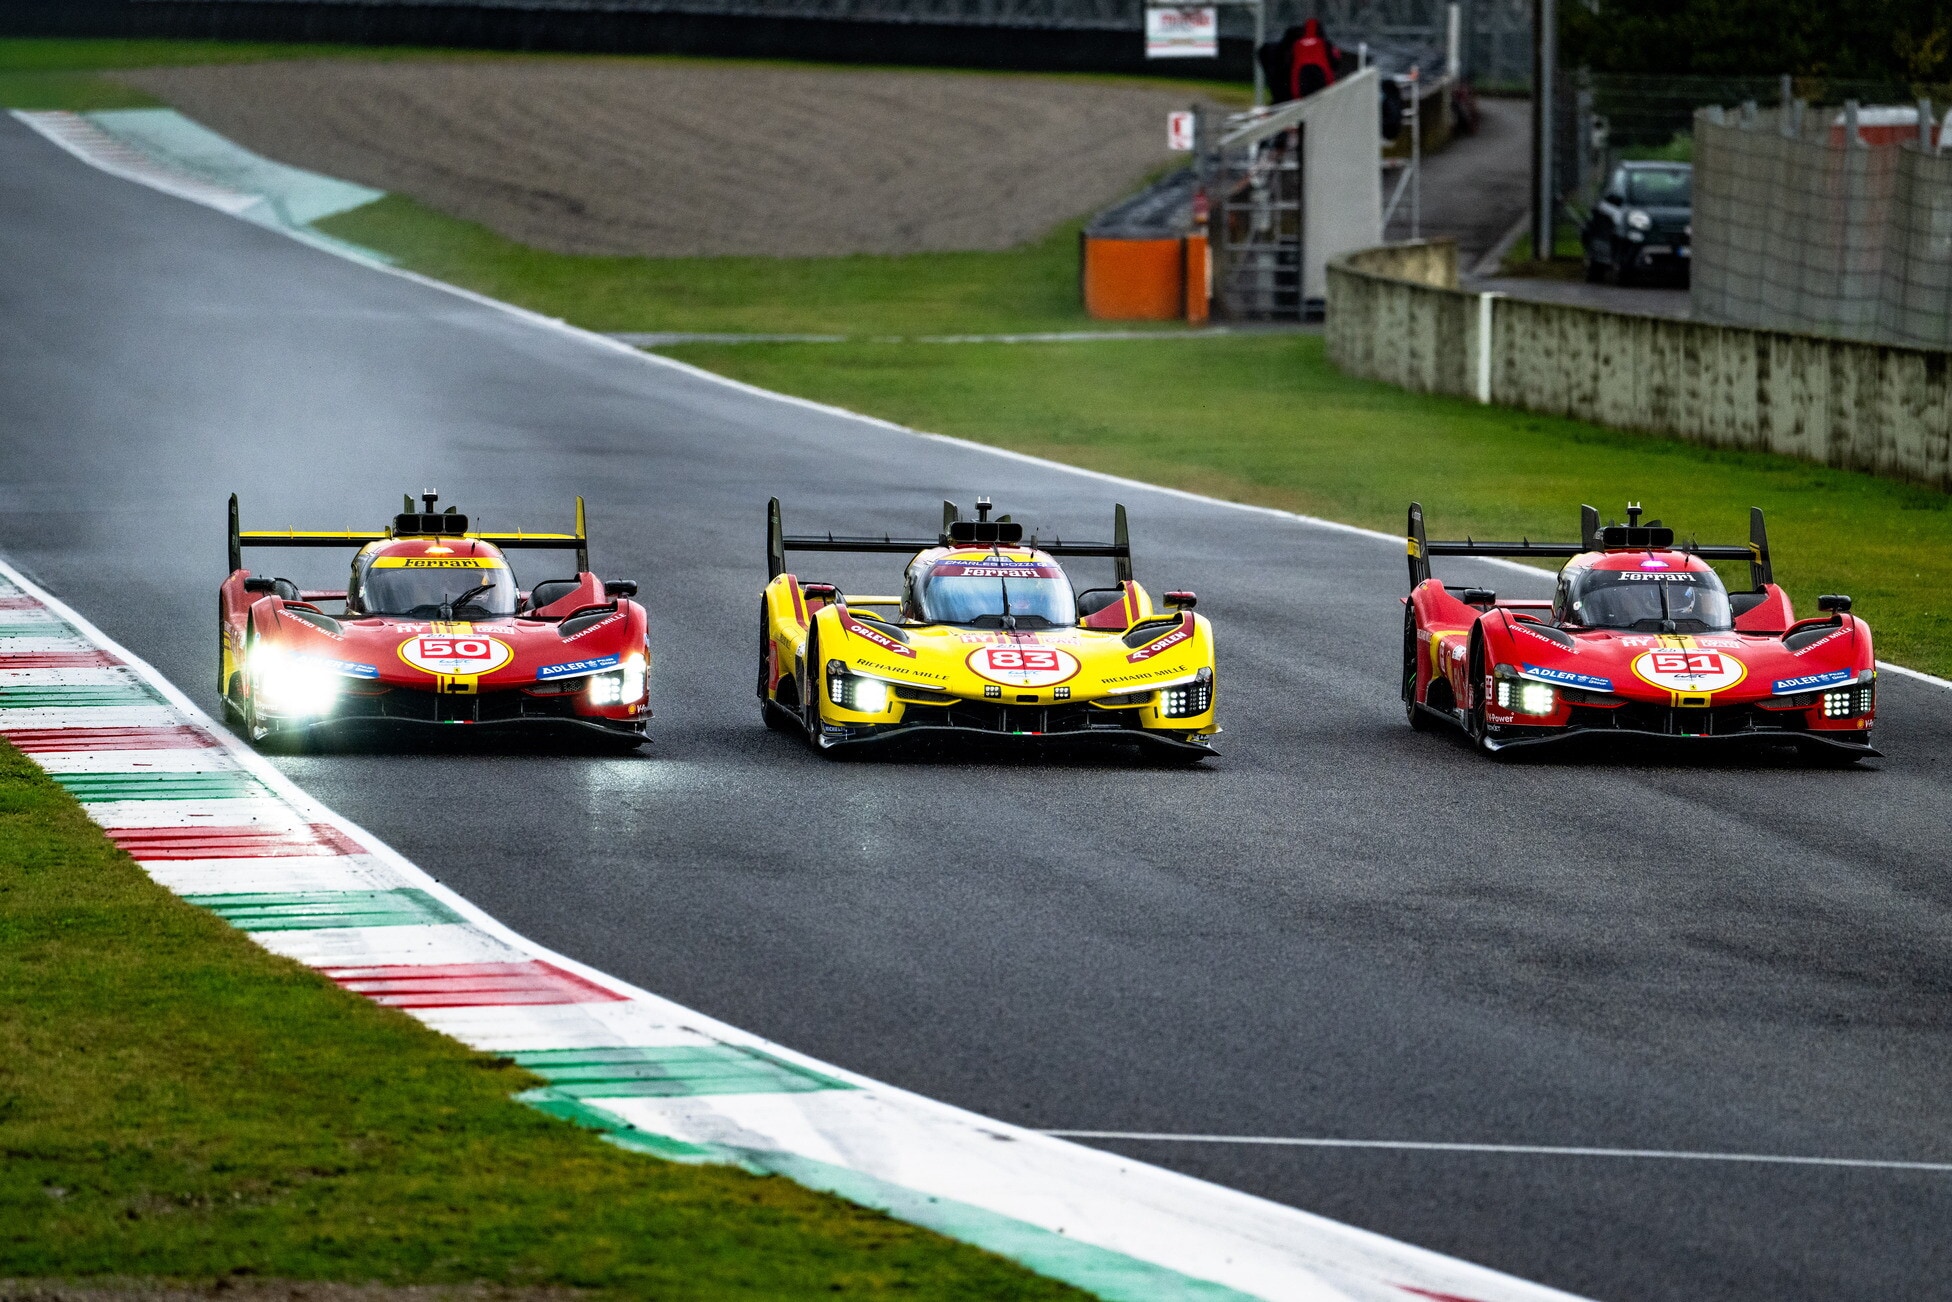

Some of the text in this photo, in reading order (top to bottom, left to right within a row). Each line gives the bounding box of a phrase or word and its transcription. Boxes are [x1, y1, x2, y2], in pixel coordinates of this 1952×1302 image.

[403, 558, 481, 568] Ferrari
[960, 566, 1040, 578] Ferrari
[1618, 571, 1697, 582] Ferrari
[277, 608, 344, 641] RICHARD MILLE
[562, 612, 626, 644] RICHARD MILLE
[850, 625, 892, 646] ORLEN
[1150, 631, 1188, 652] ORLEN
[1508, 624, 1580, 655] RICHARD MILLE
[1793, 627, 1854, 657] RICHARD MILLE
[423, 640, 487, 656] 50
[991, 651, 1056, 668] 83
[1655, 654, 1721, 671] 51
[543, 662, 588, 675] ADLER
[857, 658, 950, 681] RICHARD MILLE
[1101, 664, 1188, 684] RICHARD MILLE
[1527, 667, 1577, 681] ADLER
[1777, 675, 1820, 689] ADLER
